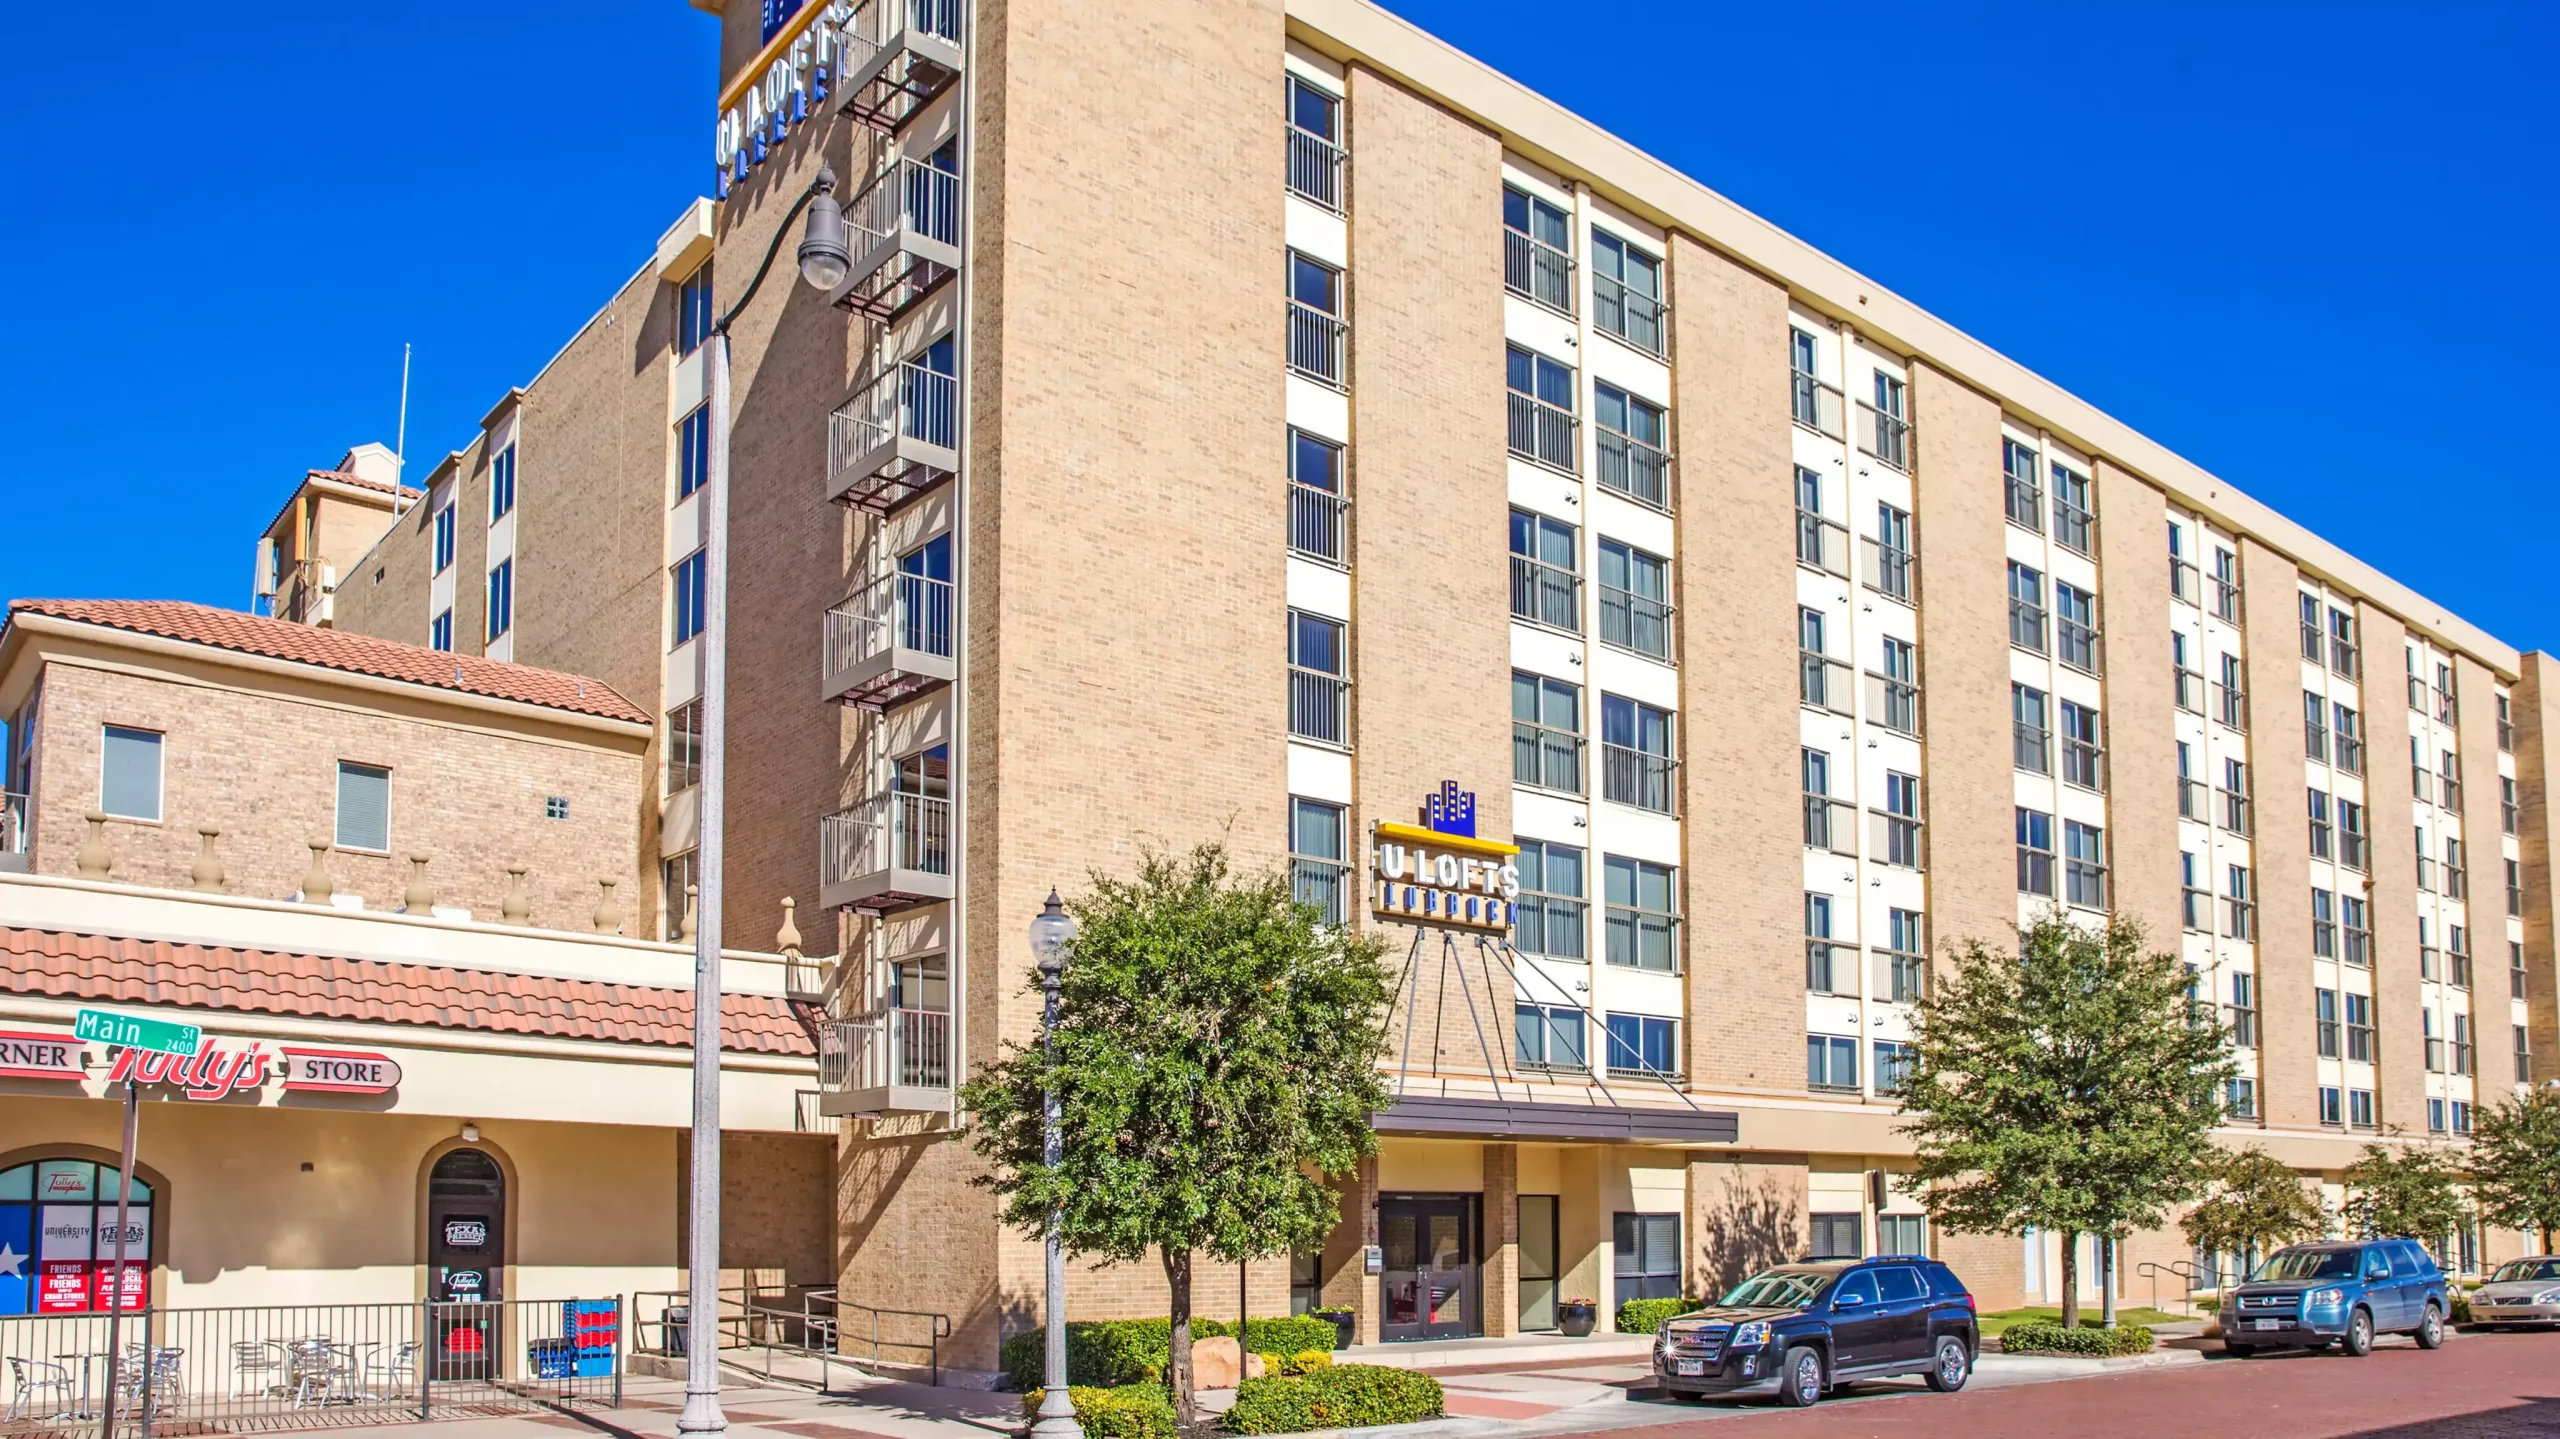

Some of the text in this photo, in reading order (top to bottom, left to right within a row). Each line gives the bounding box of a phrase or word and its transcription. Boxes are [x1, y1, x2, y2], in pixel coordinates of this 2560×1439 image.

[1380, 843, 1520, 898] U LOFTS
[1383, 881, 1518, 925] LUBBOCK
[79, 1013, 195, 1044] Main St
[165, 1039, 193, 1054] 2400
[305, 1060, 383, 1083] STORE
[45, 1227, 90, 1236] UNIVERSITY
[100, 1226, 144, 1236] TEAS
[445, 1226, 485, 1236] TEXAS
[50, 1264, 82, 1274] FRIENDS
[49, 1279, 82, 1289] FRIENDS
[101, 1284, 115, 1292] PLA
